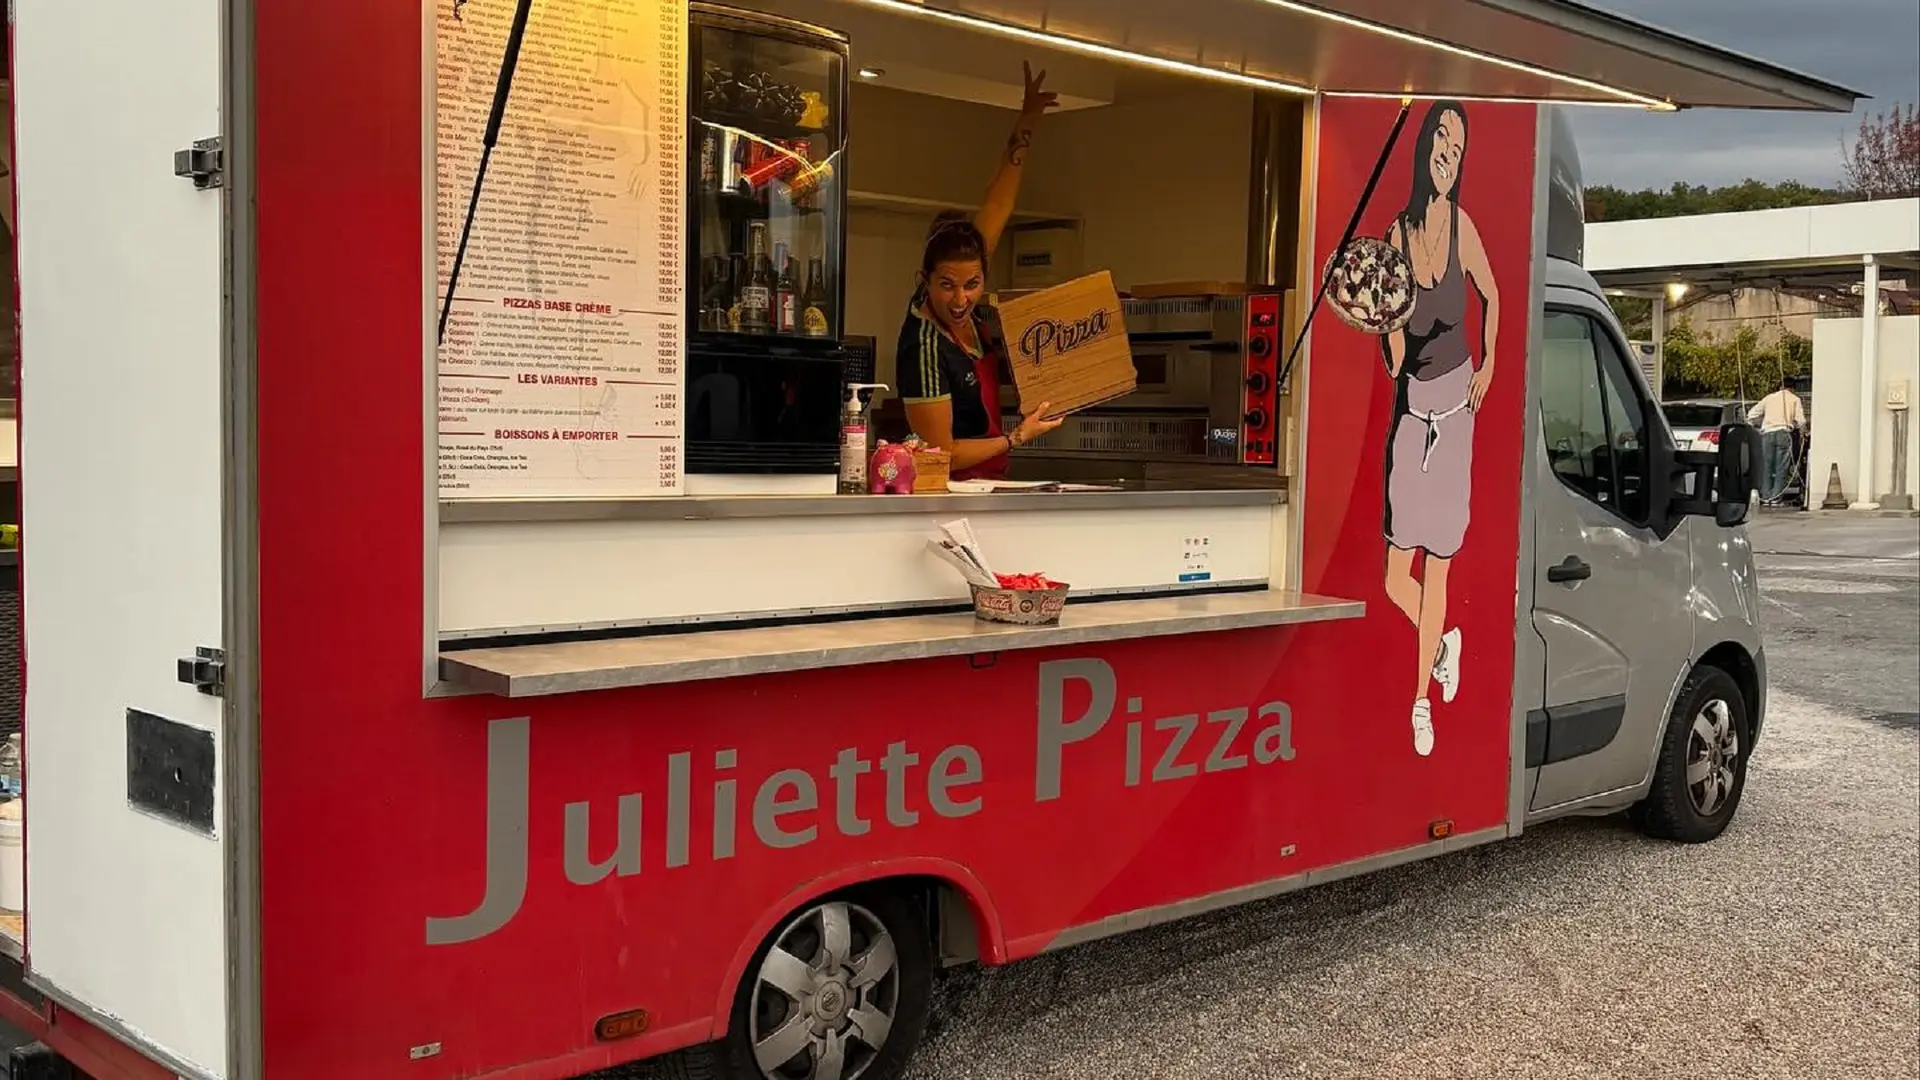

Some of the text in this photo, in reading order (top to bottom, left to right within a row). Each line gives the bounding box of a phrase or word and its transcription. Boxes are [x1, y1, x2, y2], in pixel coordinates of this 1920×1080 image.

[503, 298, 612, 314] PIZZAS BASE CRÈME
[1018, 308, 1112, 368] Pizza
[518, 374, 598, 386] LES VARIANTES
[494, 429, 618, 440] BOISSONS À EMPORTER
[426, 658, 1297, 946] Juliette Pizza
